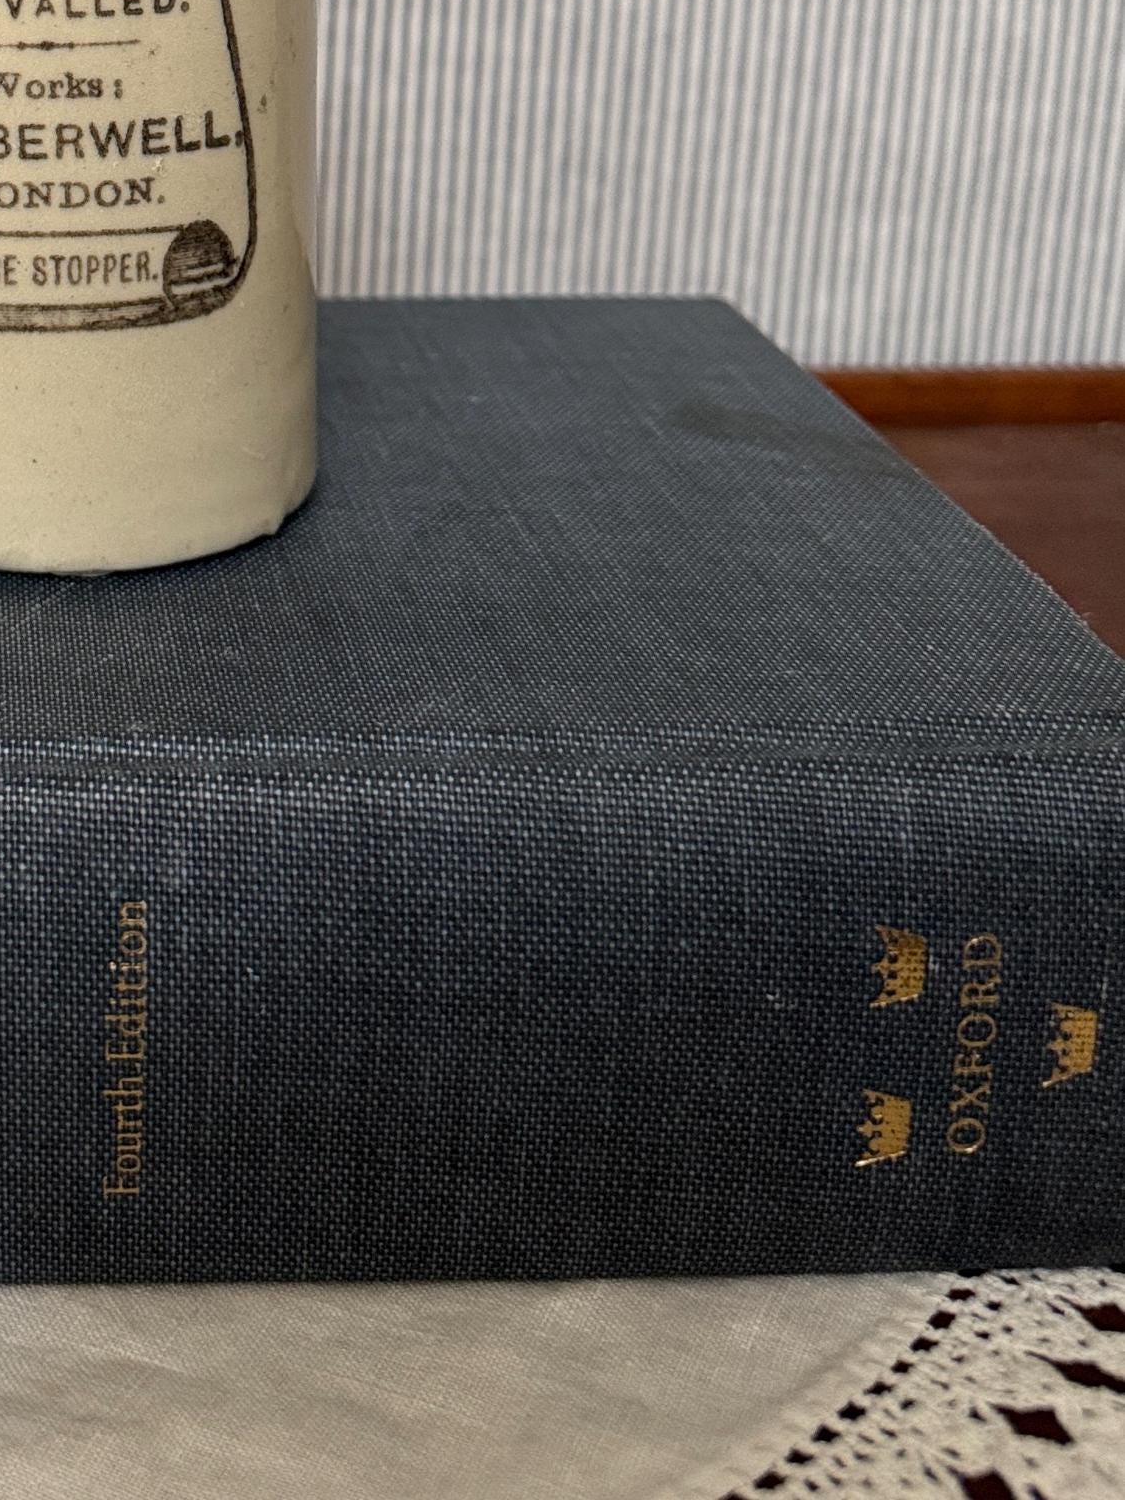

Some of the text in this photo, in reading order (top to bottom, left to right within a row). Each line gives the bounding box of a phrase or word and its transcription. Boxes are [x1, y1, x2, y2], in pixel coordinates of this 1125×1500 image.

[32, 251, 159, 287] STOPPER.
[101, 900, 148, 1199] Fourth Edition
[946, 932, 1002, 1153] OXFORD
